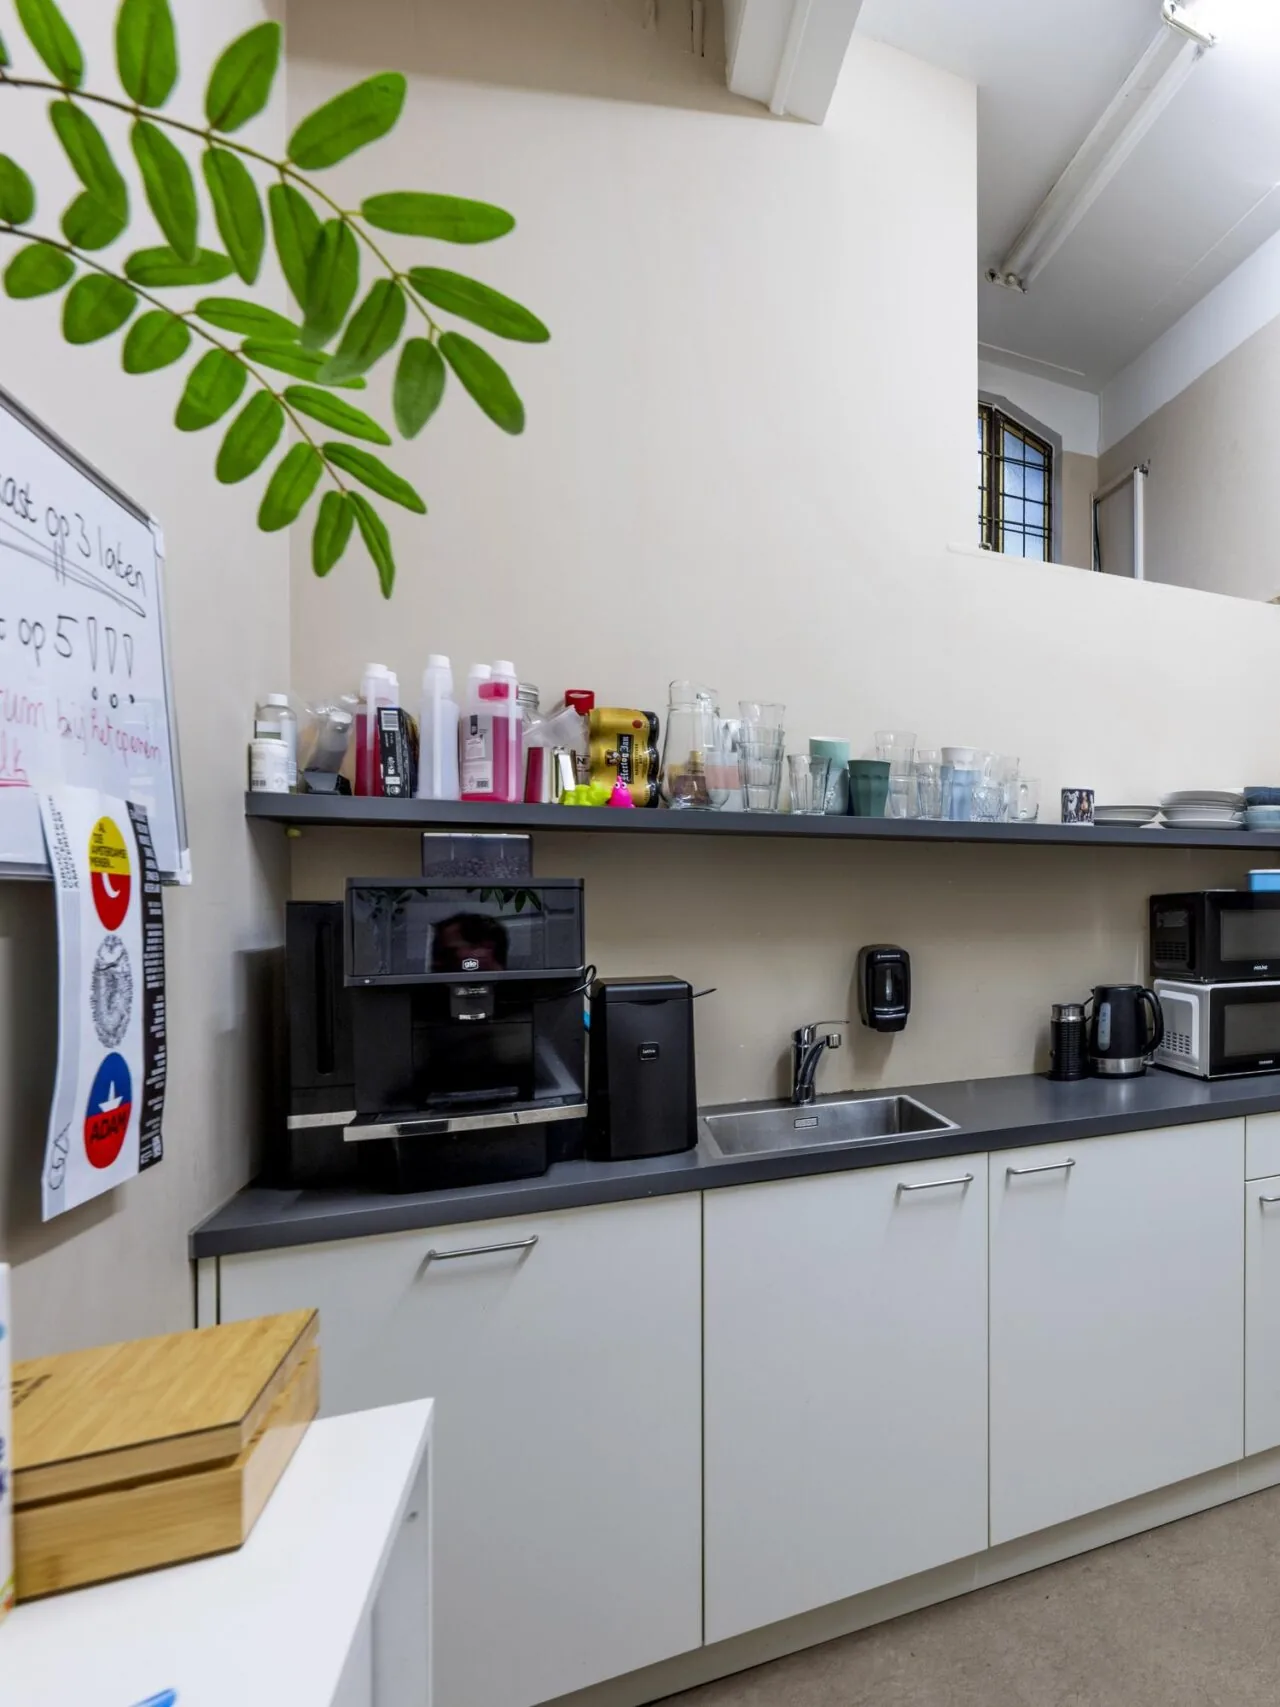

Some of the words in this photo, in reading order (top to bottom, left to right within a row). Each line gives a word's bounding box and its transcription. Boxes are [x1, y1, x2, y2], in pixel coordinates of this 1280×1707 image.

[0, 476, 37, 523] ast
[45, 506, 70, 556] op
[74, 512, 91, 558] 3
[97, 524, 147, 598] laten
[18, 618, 46, 668] op
[620, 736, 629, 752] Jan
